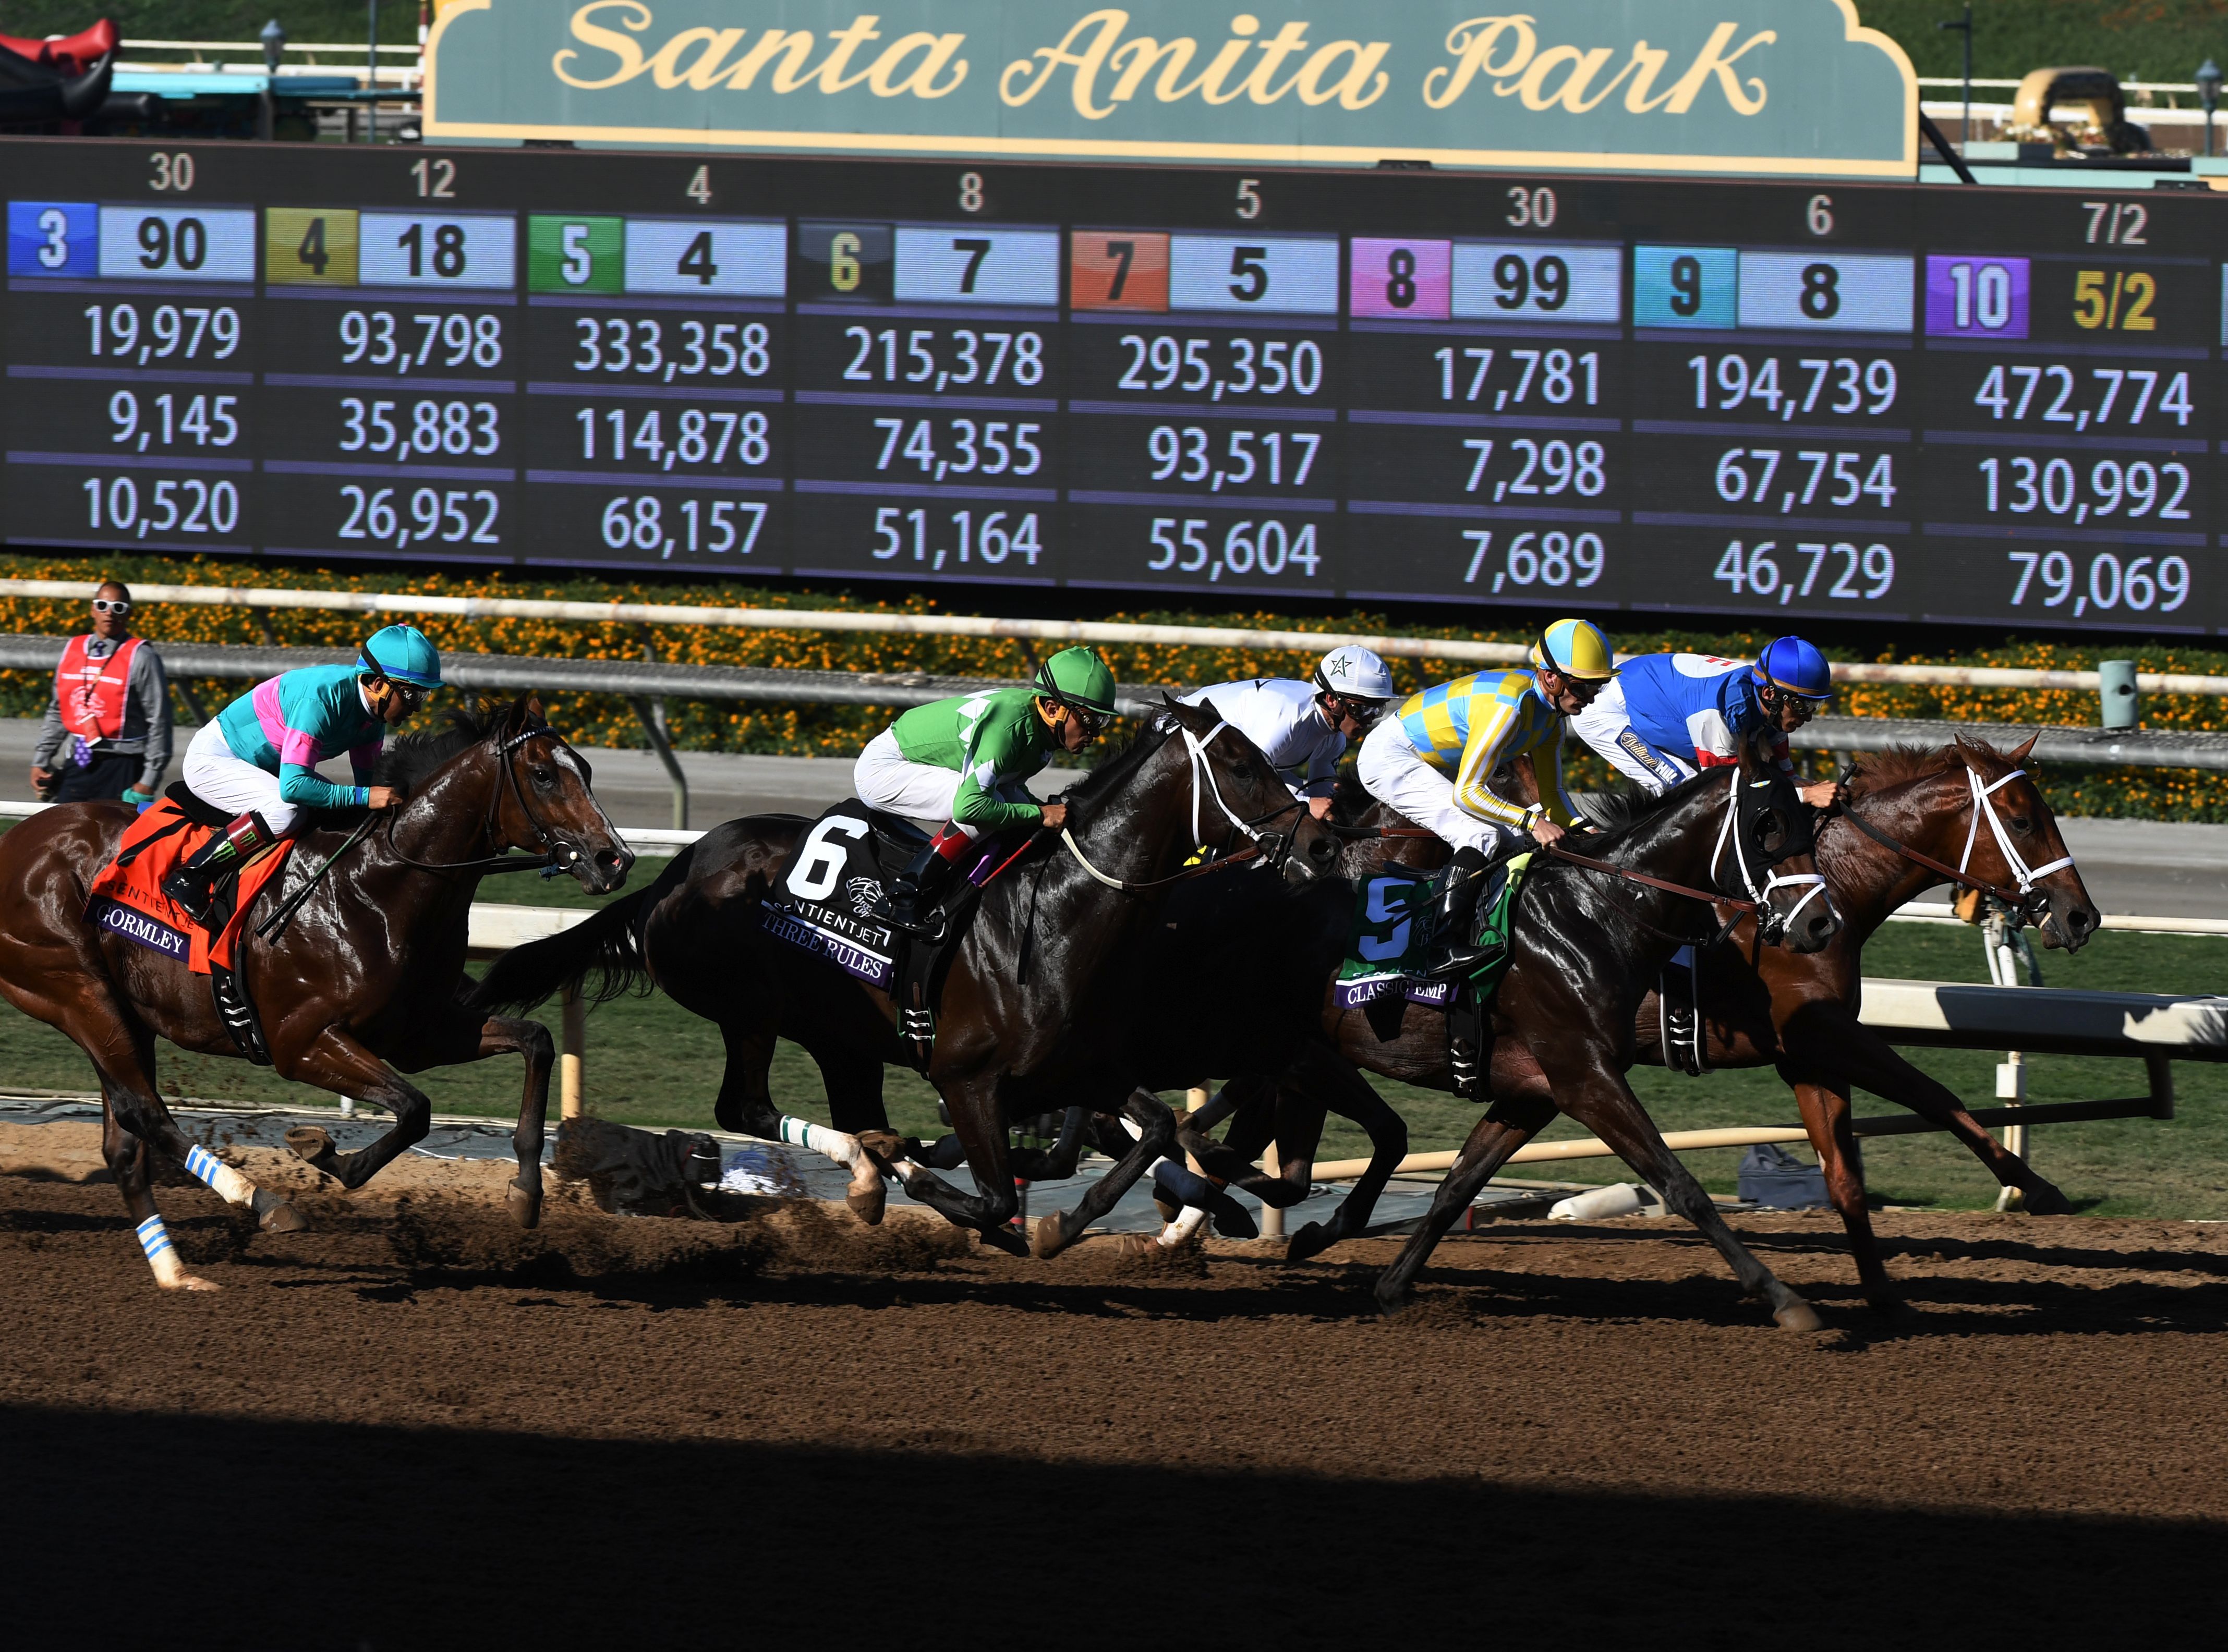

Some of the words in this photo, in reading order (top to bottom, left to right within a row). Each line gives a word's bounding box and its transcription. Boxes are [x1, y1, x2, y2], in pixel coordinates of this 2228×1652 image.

[553, 0, 968, 98] Santa
[1000, 9, 1390, 119] Anita
[150, 153, 194, 190] 30
[412, 159, 455, 197] 12
[687, 166, 711, 204] 4
[960, 173, 983, 211] 8
[1237, 179, 1261, 218] 5
[1508, 187, 1556, 227] 30
[1808, 195, 1833, 235] 6
[2084, 203, 2147, 244] 7/2
[37, 208, 68, 270] 3
[138, 217, 206, 270] 90
[298, 218, 329, 276] 4
[399, 224, 466, 278] 18
[563, 226, 589, 283] 5
[678, 232, 717, 285] 4
[831, 233, 861, 291] 6
[954, 239, 990, 293] 7
[1108, 241, 1133, 300] 7
[1230, 247, 1267, 301] 5
[1387, 250, 1415, 309] 8
[1494, 255, 1569, 311] 99
[1670, 257, 1701, 317] 9
[1800, 264, 1839, 320] 8
[1950, 263, 2011, 330] 10
[2075, 271, 2155, 330] 5/2
[86, 305, 239, 365] 19,979
[341, 311, 501, 374] 93,798
[575, 318, 769, 382] 333,358
[844, 326, 1043, 392] 215,378
[1119, 336, 1322, 400] 295,350
[1436, 348, 1597, 410] 17,781
[1689, 355, 1896, 420] 194,739
[1975, 366, 2193, 431] 472,774
[110, 391, 237, 452] 9,145
[341, 398, 499, 460] 35,883
[578, 409, 769, 471] 114,878
[875, 419, 1040, 481] 74,355
[1149, 427, 1320, 491] 93,517
[1464, 439, 1605, 502] 7,298
[1716, 449, 1896, 513] 67,754
[1980, 457, 2189, 524] 130,992
[84, 478, 238, 538] 10,520
[340, 486, 498, 548] 26,952
[603, 496, 767, 560] 68,157
[874, 508, 1041, 569] 51,164
[1149, 519, 1319, 581] 55,604
[1463, 531, 1604, 592] 7,689
[1715, 541, 1894, 604] 46,729
[2009, 552, 2189, 617] 79,069
[1620, 732, 1661, 768] William
[786, 815, 869, 901] 6
[96, 904, 184, 954] GORMLEY
[762, 912, 823, 952] THREE
[825, 939, 883, 979] RULES
[1358, 877, 1418, 961] 5
[1348, 979, 1409, 1004] CLASSIC
[1414, 982, 1447, 1000] EMP
